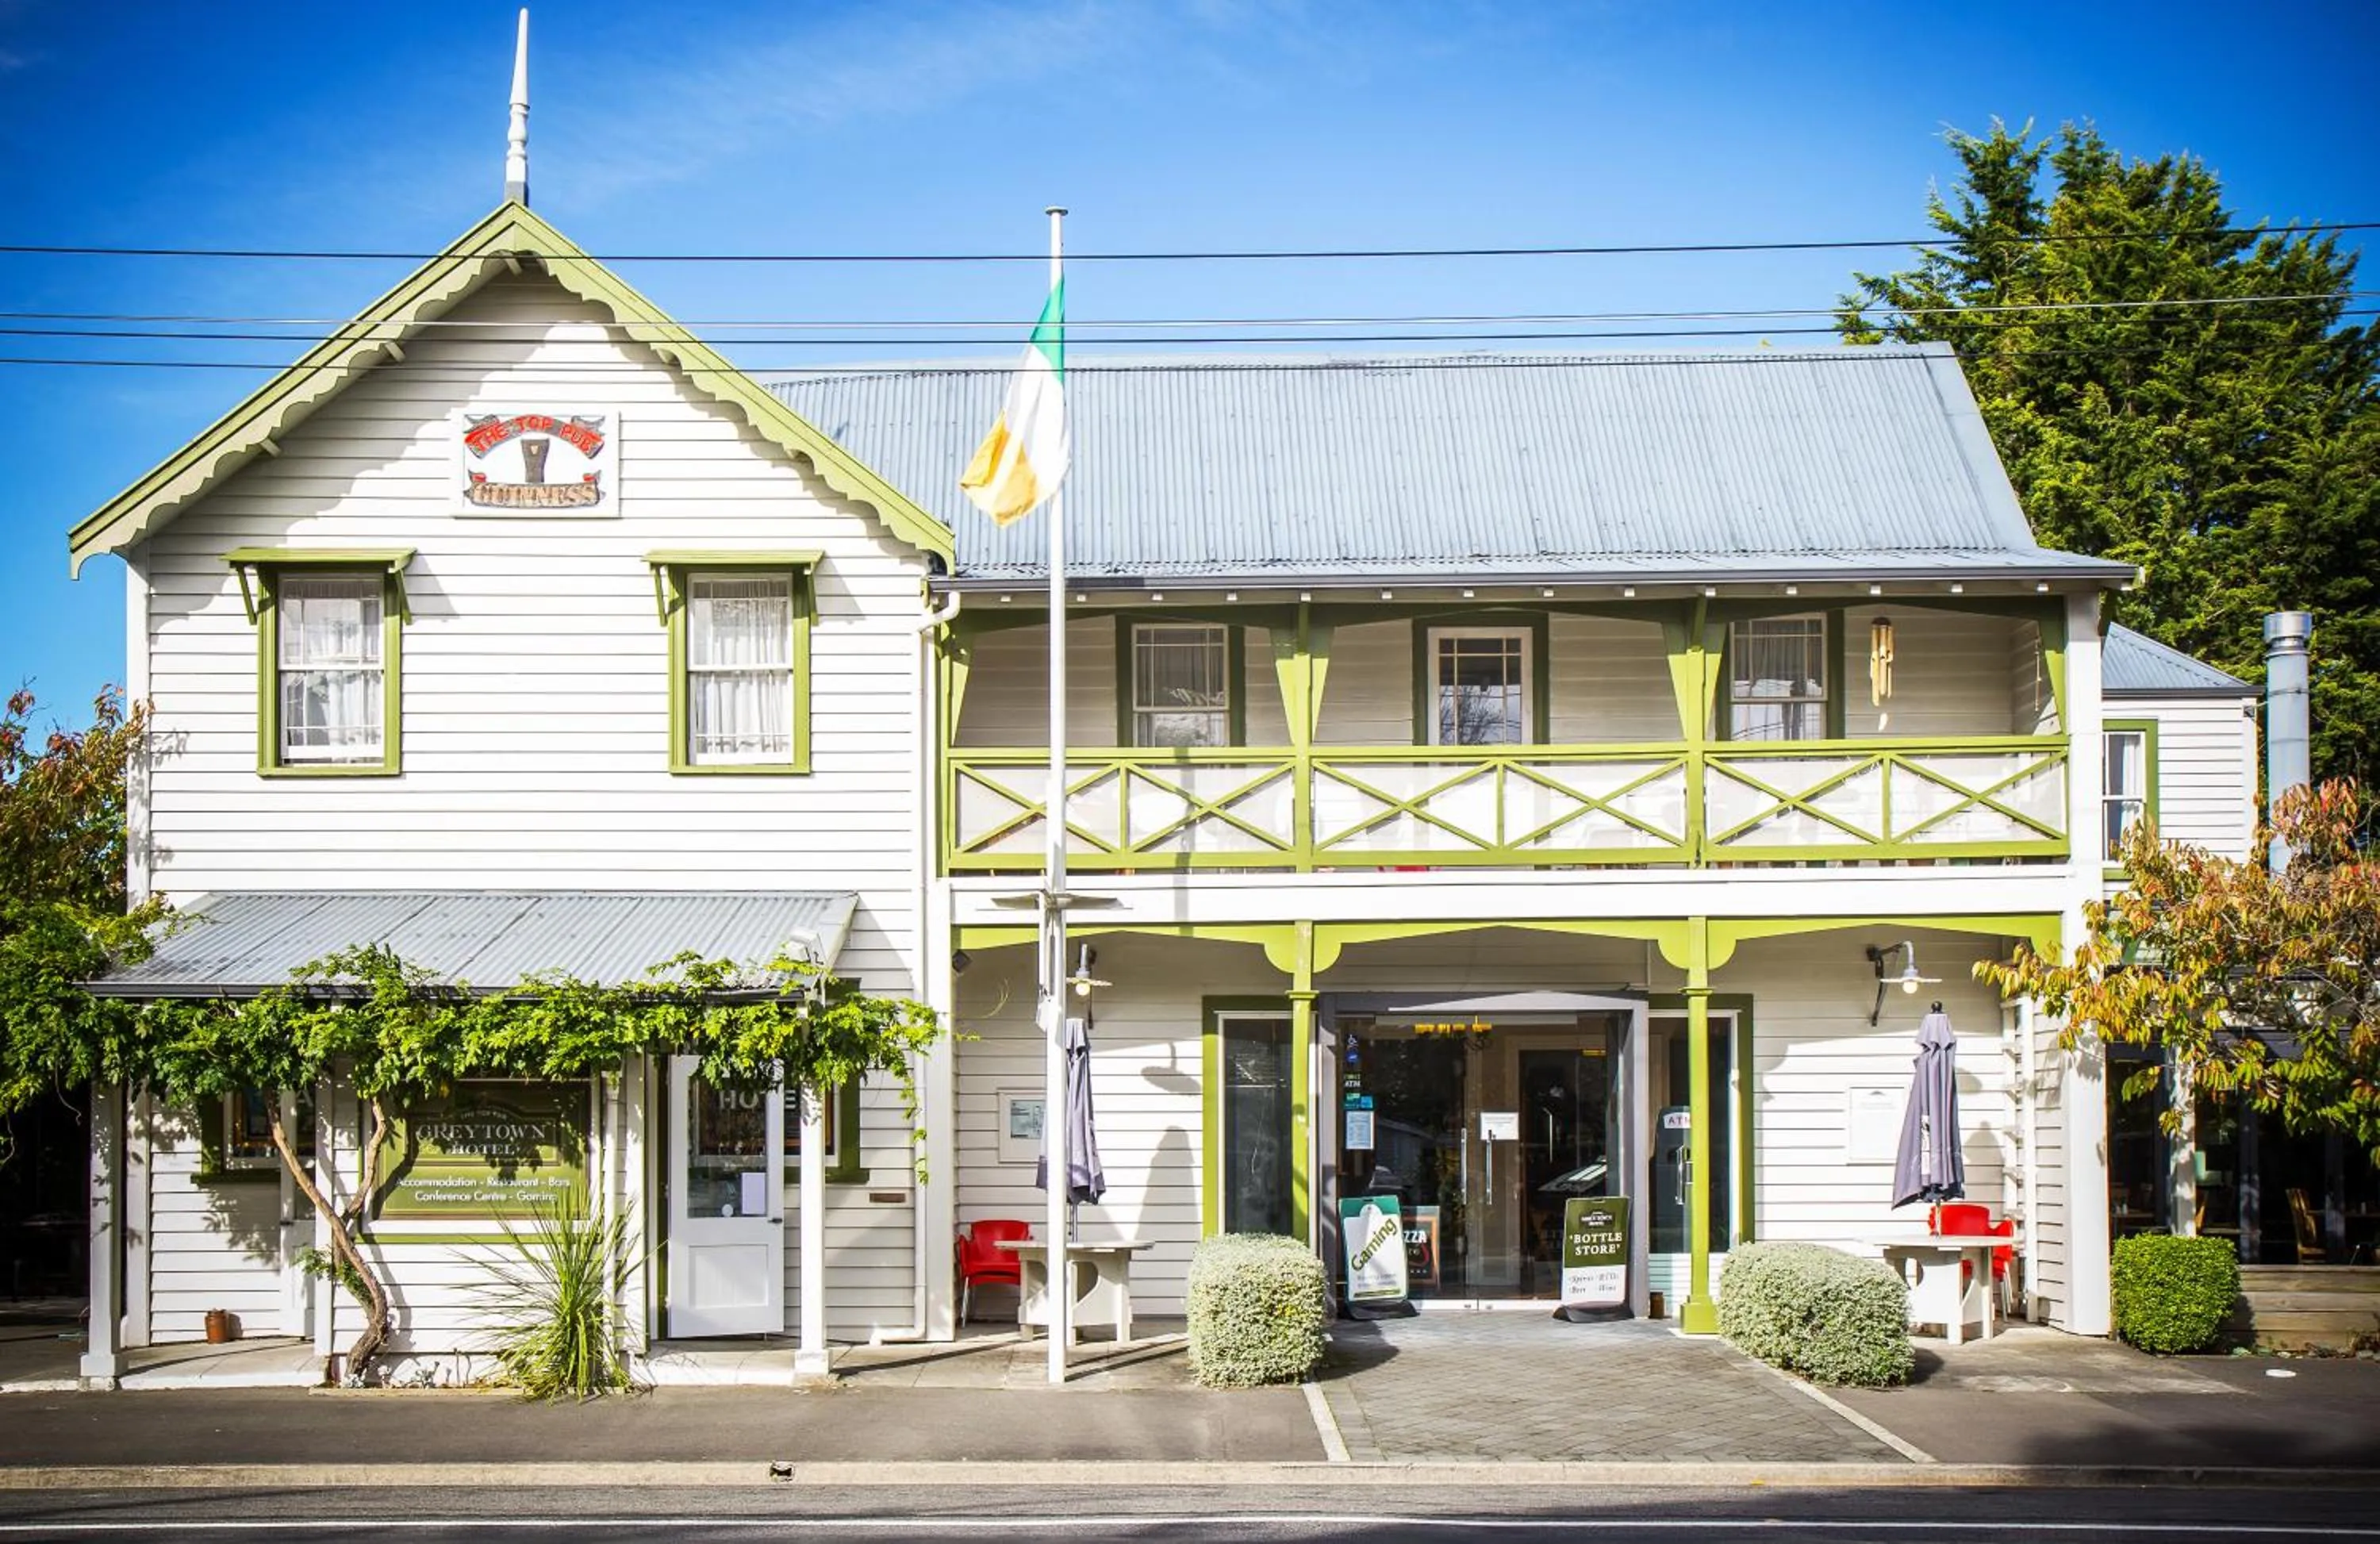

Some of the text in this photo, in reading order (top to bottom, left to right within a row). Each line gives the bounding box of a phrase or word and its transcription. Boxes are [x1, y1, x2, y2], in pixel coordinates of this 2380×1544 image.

[474, 415, 593, 453] THE TOP PUB
[474, 483, 595, 505] GUINNESS
[417, 1123, 545, 1139] GREYTOWN
[450, 1143, 515, 1155] HOTEL
[415, 1190, 471, 1201] Conference
[474, 1190, 507, 1201] Centre
[516, 1190, 559, 1204] Gaming
[1351, 1218, 1398, 1271] Gaming
[1403, 1230, 1427, 1244] ZZA
